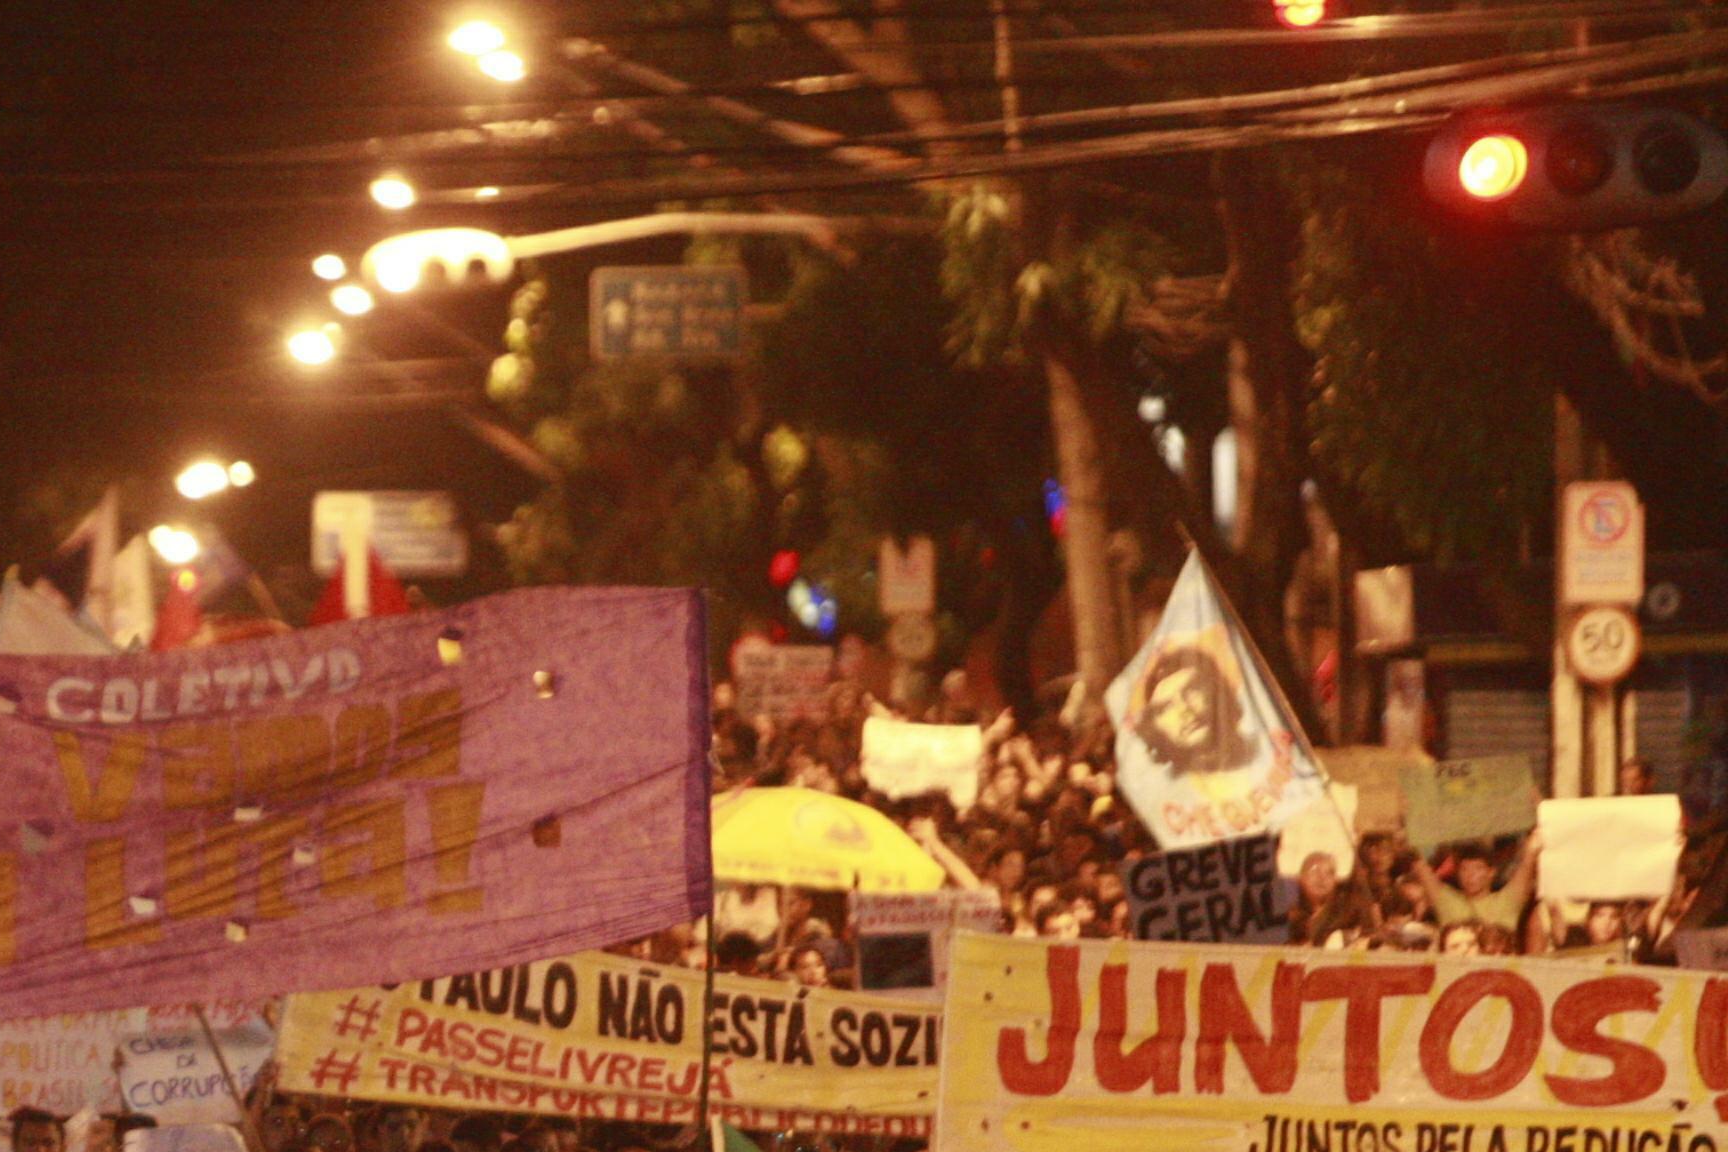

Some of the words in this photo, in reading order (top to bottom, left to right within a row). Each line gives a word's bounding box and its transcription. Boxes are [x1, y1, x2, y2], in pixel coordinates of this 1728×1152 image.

[1582, 617, 1624, 654] 50
[46, 648, 361, 724] COLETIVO
[1129, 835, 1274, 900] GREVE
[1136, 882, 1290, 940] GERAL
[420, 961, 578, 1030] AULO
[598, 967, 684, 1045] NÃO
[709, 986, 815, 1066] ESTÁ
[830, 1007, 943, 1067] SOZI
